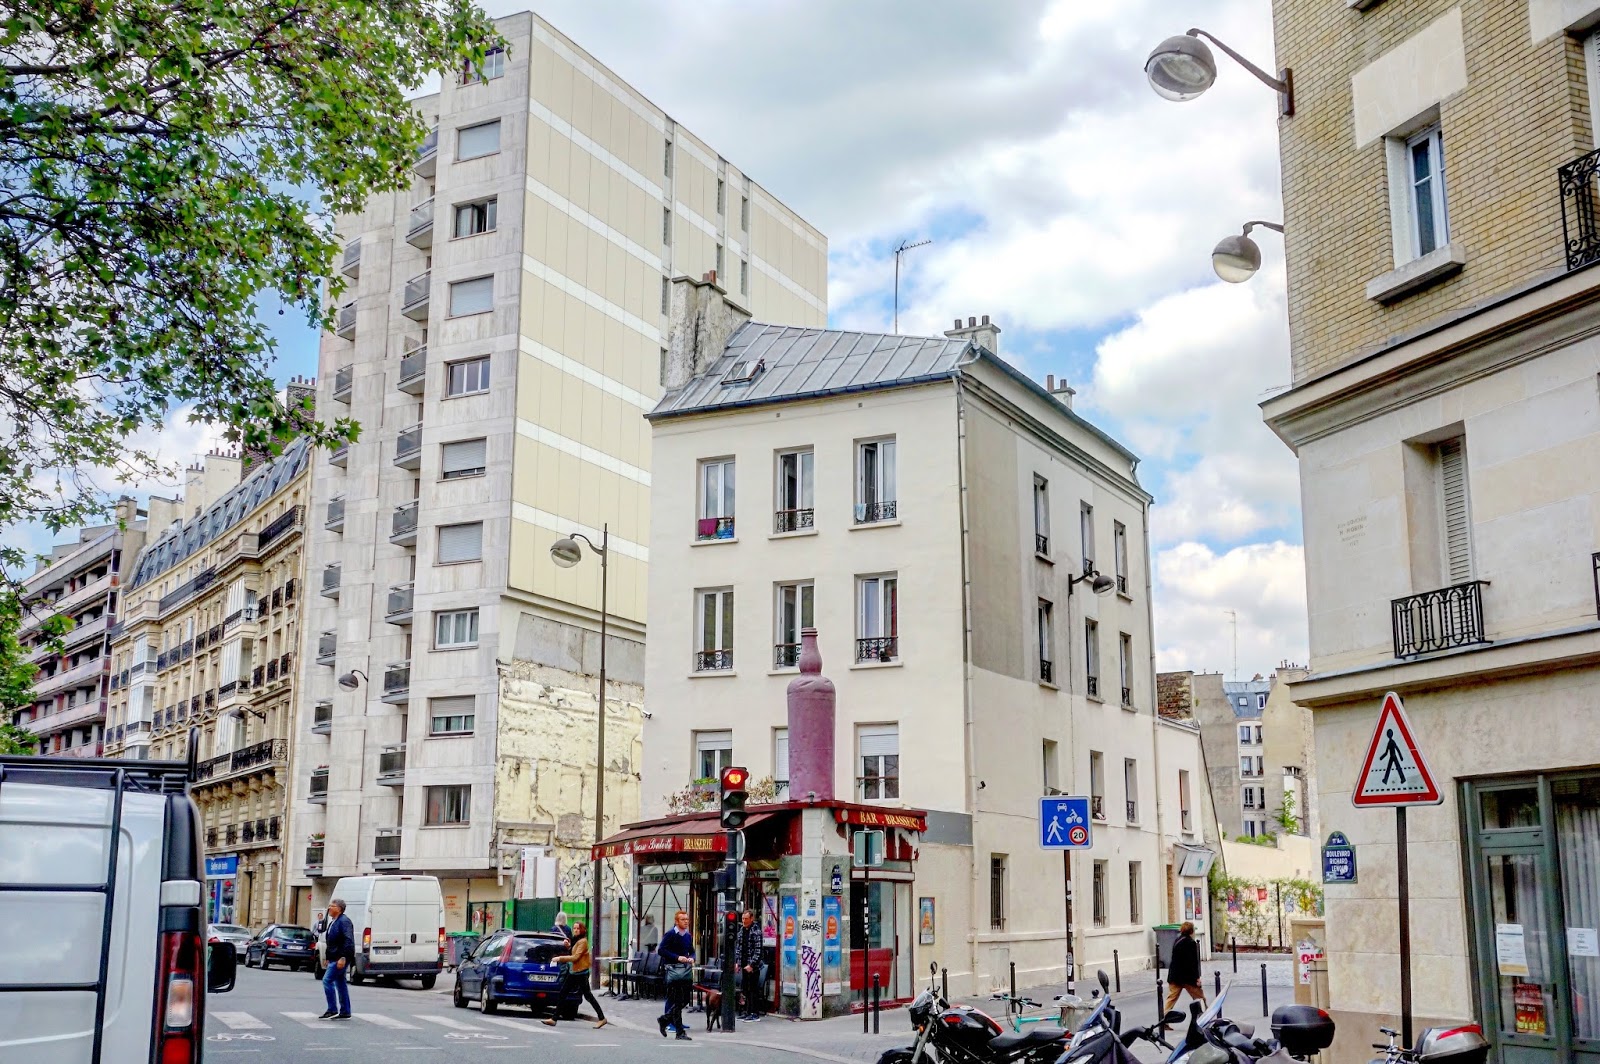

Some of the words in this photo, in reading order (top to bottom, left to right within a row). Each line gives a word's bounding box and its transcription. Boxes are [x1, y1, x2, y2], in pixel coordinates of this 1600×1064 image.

[860, 811, 878, 824] BAR
[1073, 831, 1084, 839] 20
[605, 845, 615, 856] BAR
[683, 838, 713, 850] BRASSERIE
